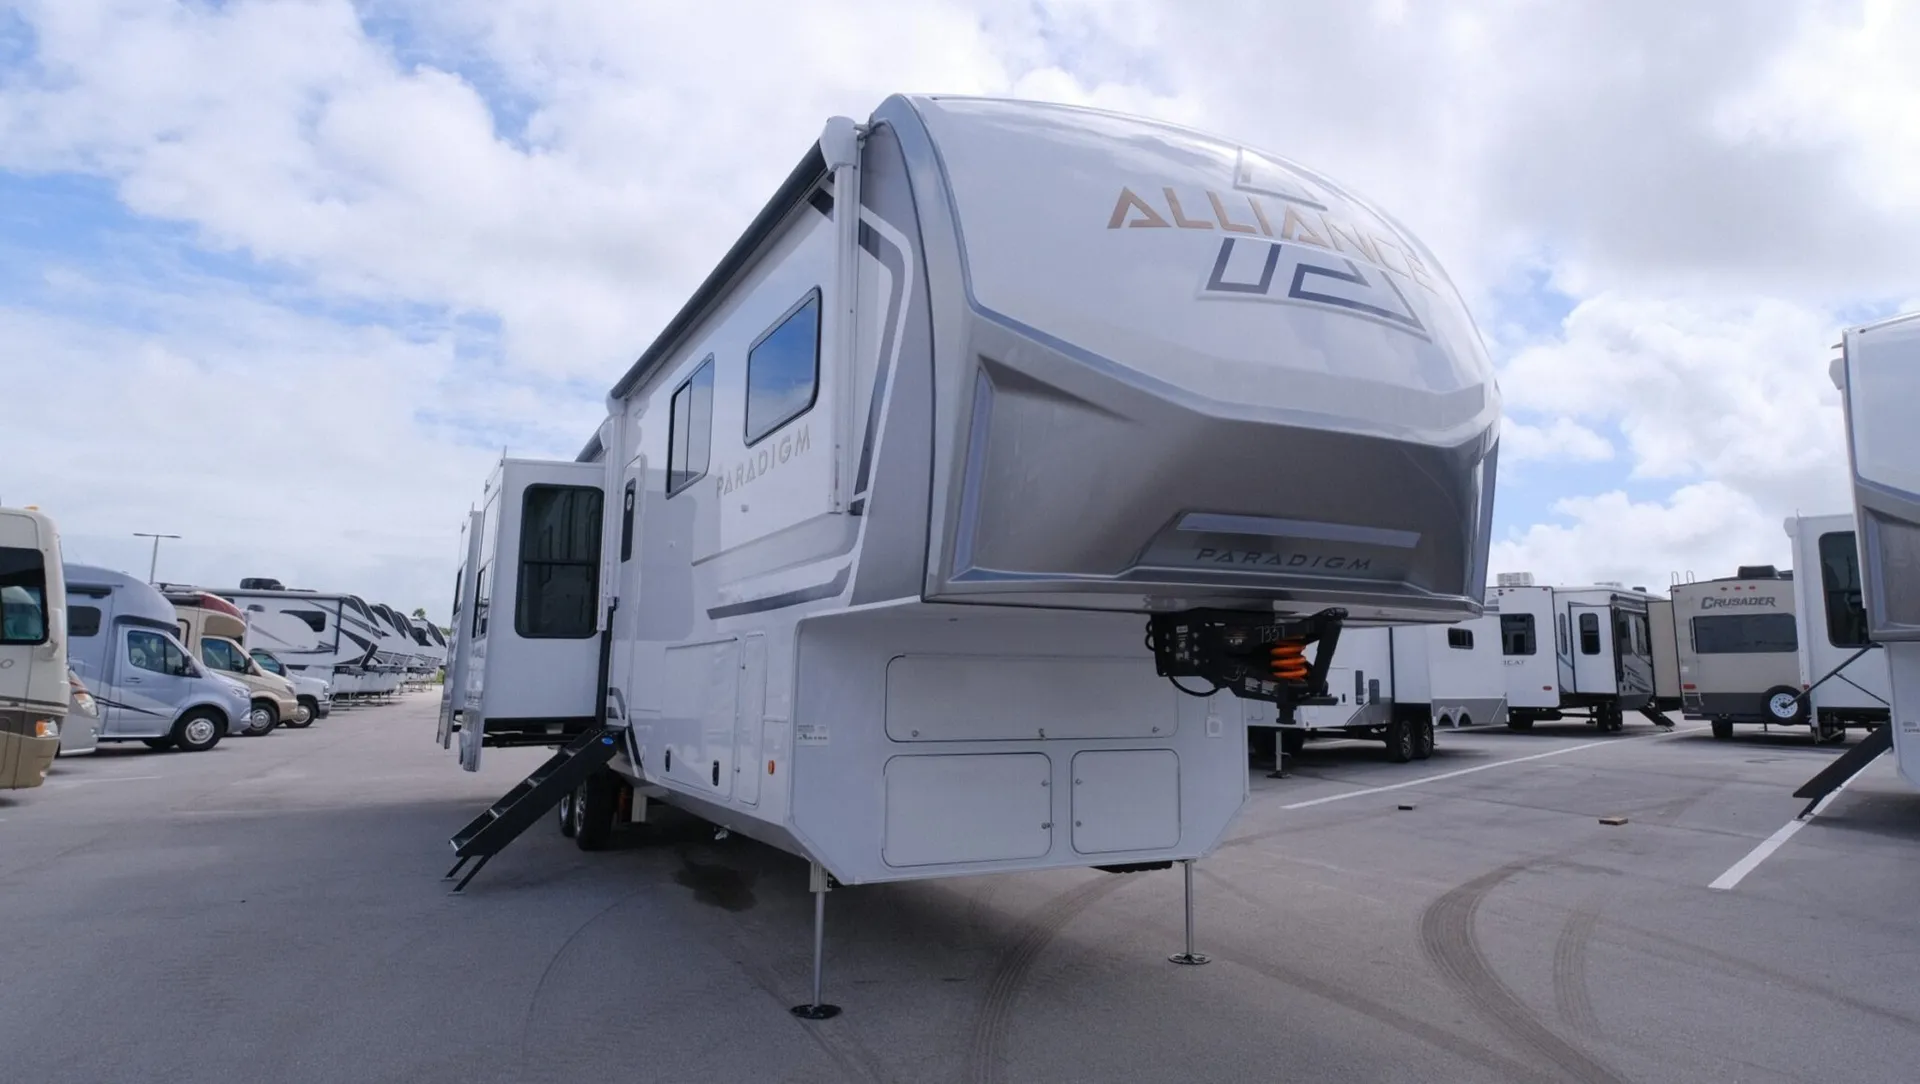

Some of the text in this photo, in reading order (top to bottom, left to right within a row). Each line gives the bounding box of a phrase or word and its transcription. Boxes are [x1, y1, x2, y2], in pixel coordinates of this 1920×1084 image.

[1106, 186, 1439, 296] ALLIANCE
[715, 423, 811, 499] PARADIGM
[1196, 548, 1372, 571] PARADIGM
[1701, 596, 1776, 610] CRUSADER
